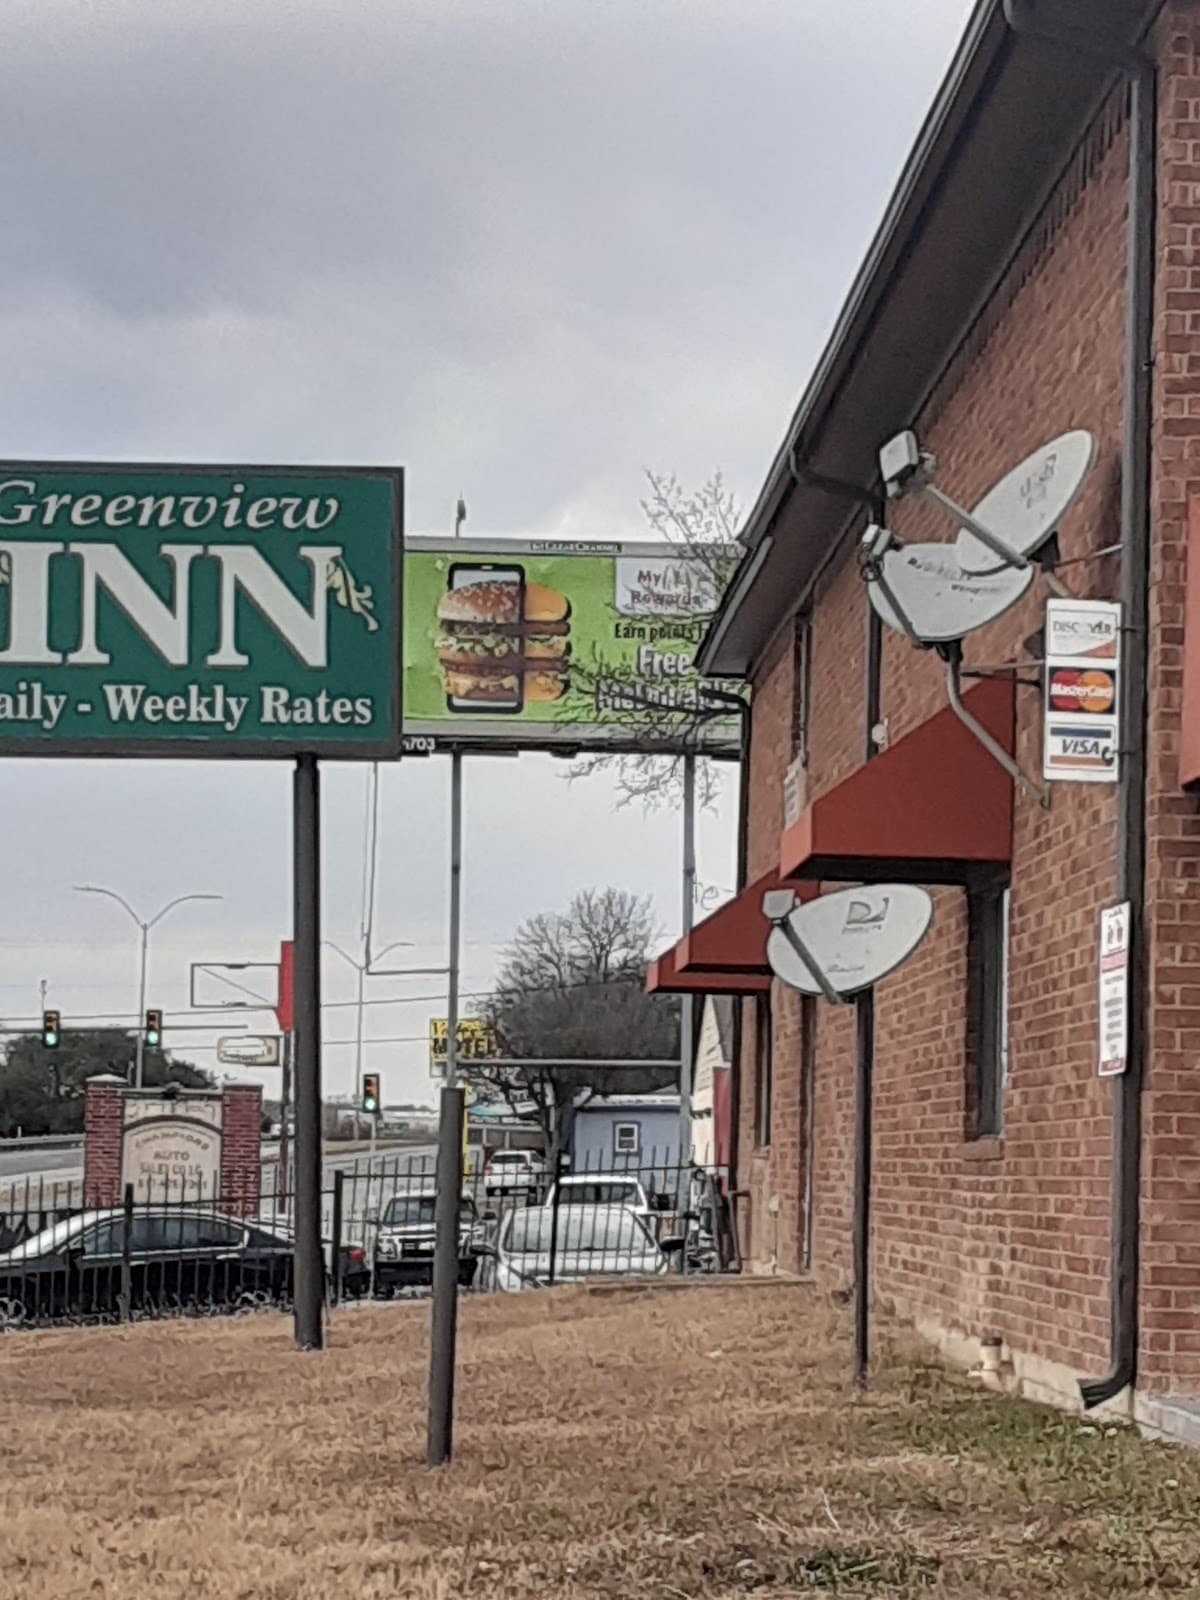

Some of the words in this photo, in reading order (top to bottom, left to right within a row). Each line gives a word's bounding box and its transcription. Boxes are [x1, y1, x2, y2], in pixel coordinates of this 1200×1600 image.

[0, 480, 339, 529] Greenview
[637, 570, 661, 585] My
[0, 541, 343, 668] INN
[614, 623, 646, 638] Earn
[649, 623, 694, 642] points
[638, 643, 692, 677] Free
[0, 681, 67, 729] aily
[103, 684, 249, 731] Weekly
[261, 686, 373, 724] Rates
[1062, 738, 1099, 754] VISA
[153, 1151, 190, 1160] AUTO
